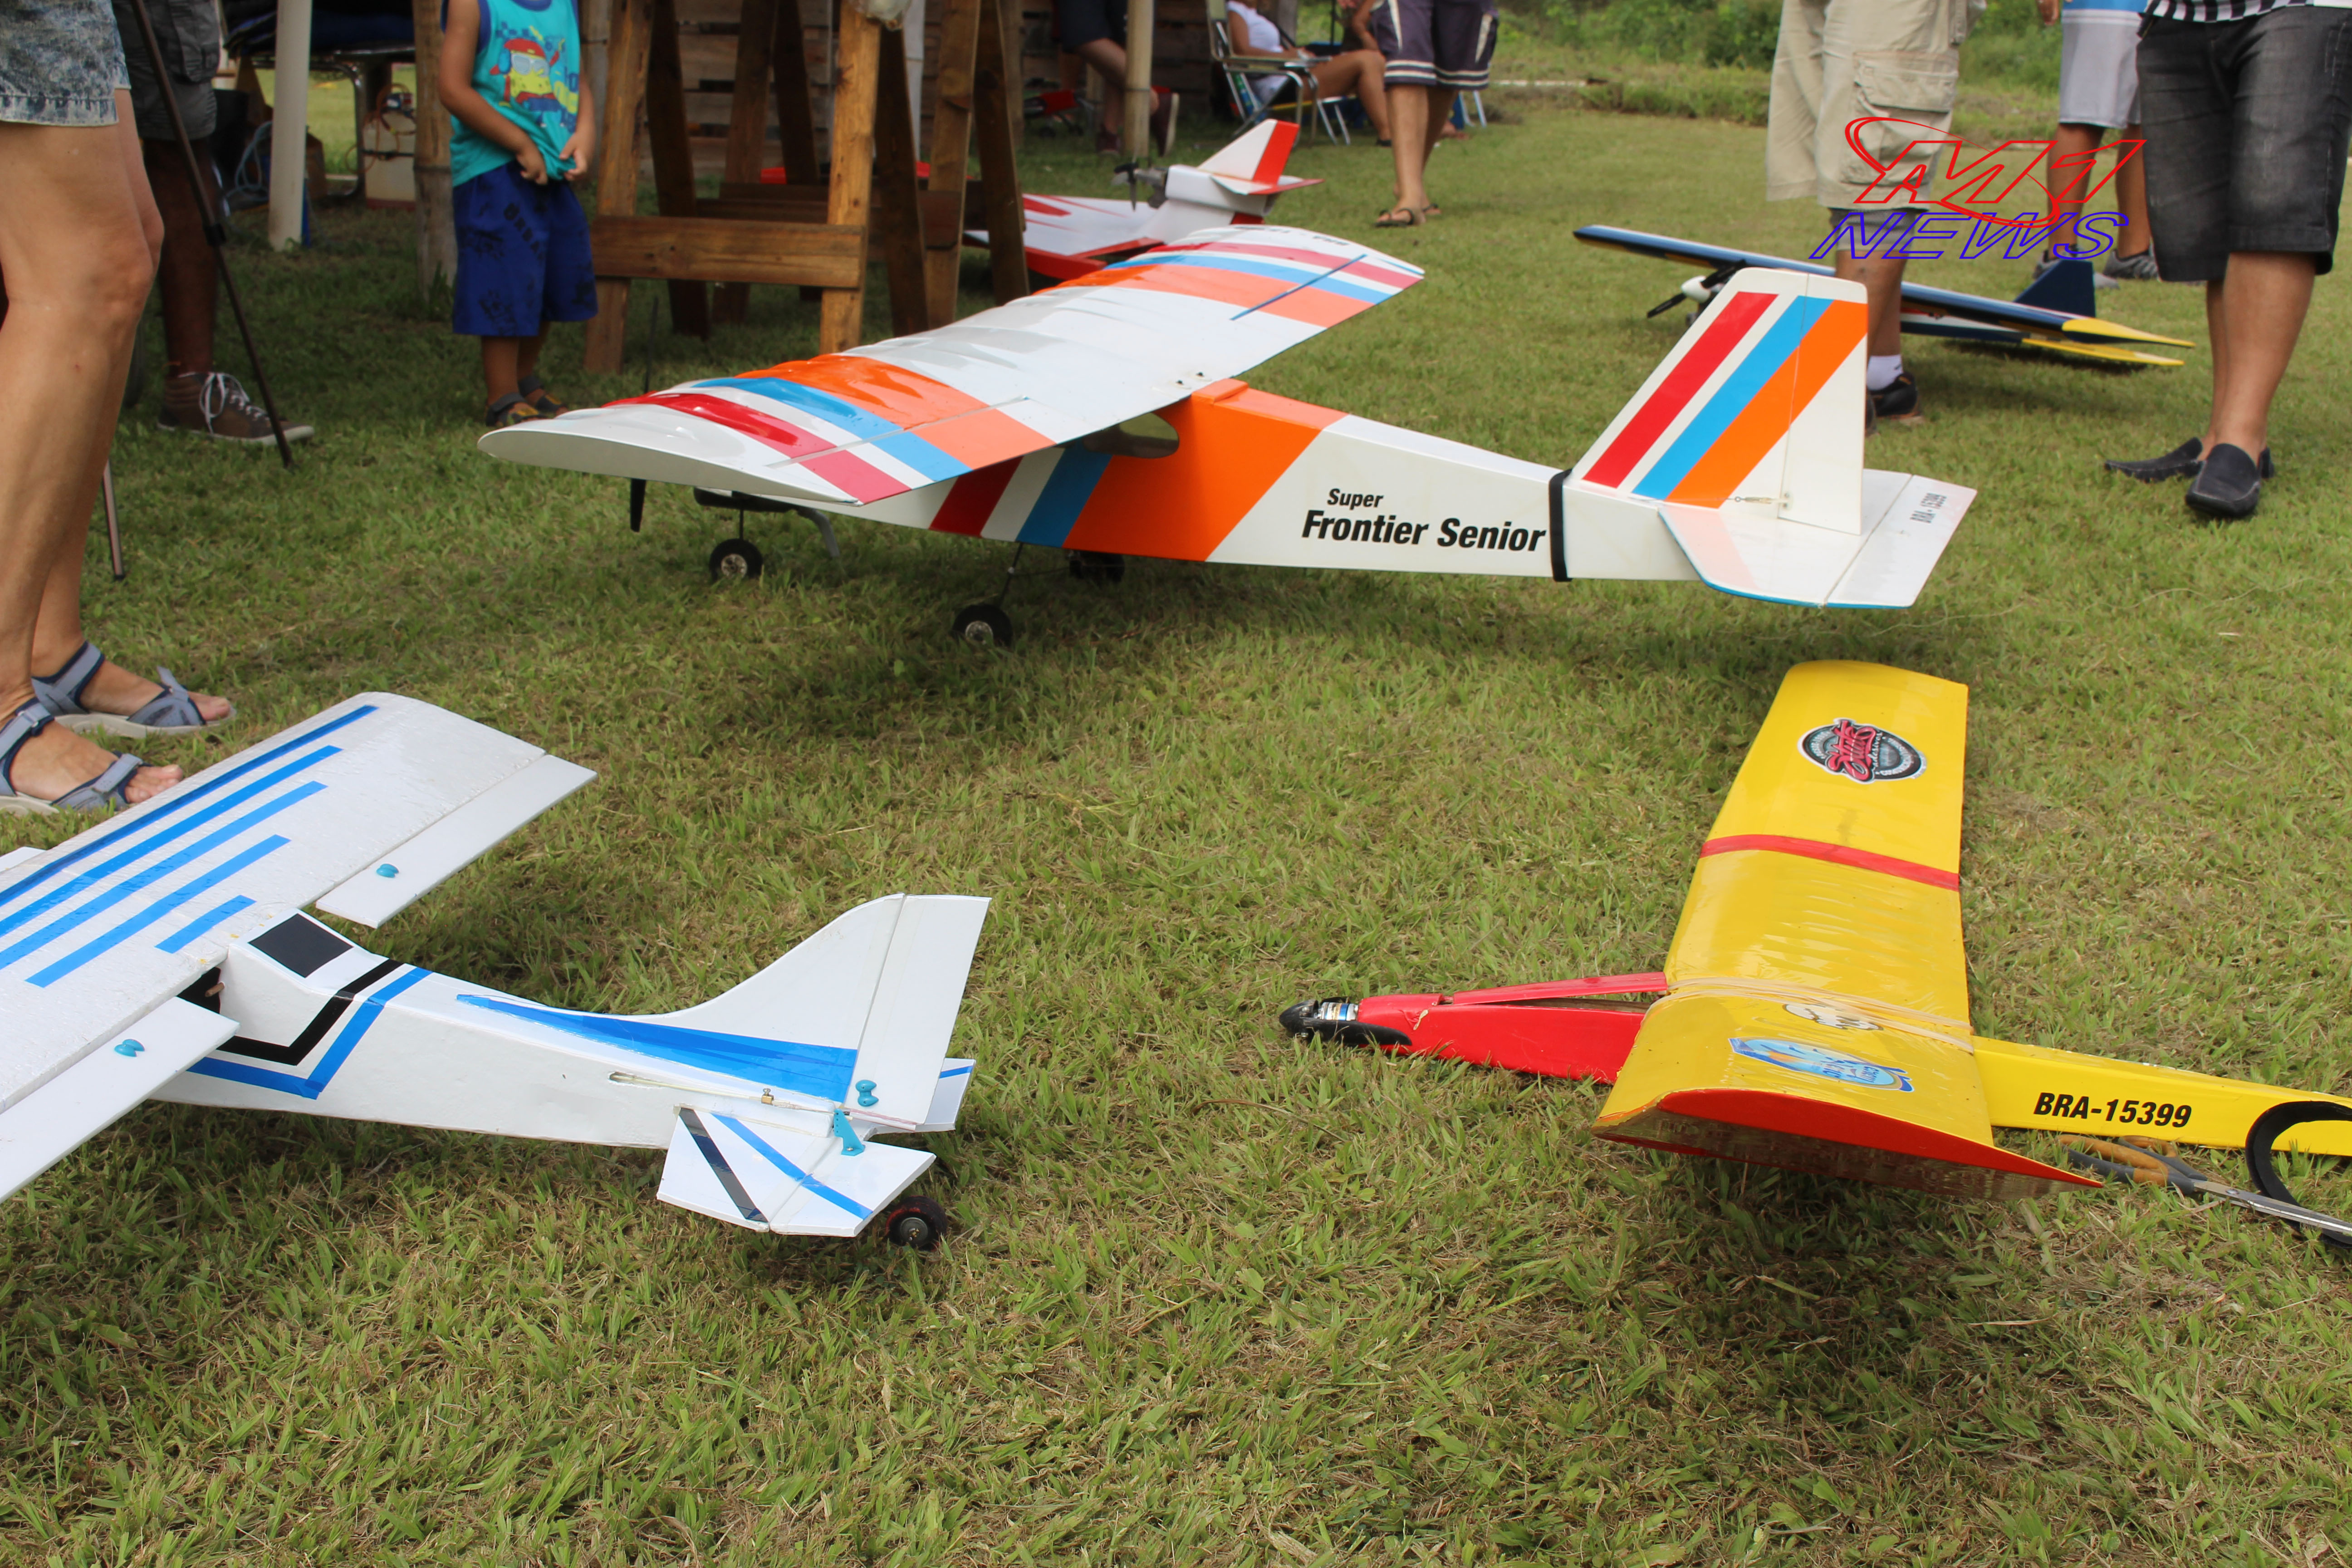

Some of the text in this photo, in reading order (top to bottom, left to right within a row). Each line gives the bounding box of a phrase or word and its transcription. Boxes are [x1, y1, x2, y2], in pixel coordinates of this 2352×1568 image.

[1327, 488, 1384, 510] Super
[1301, 510, 1547, 551] Frontier Senior
[2033, 1092, 2192, 1128] BRA-15399
